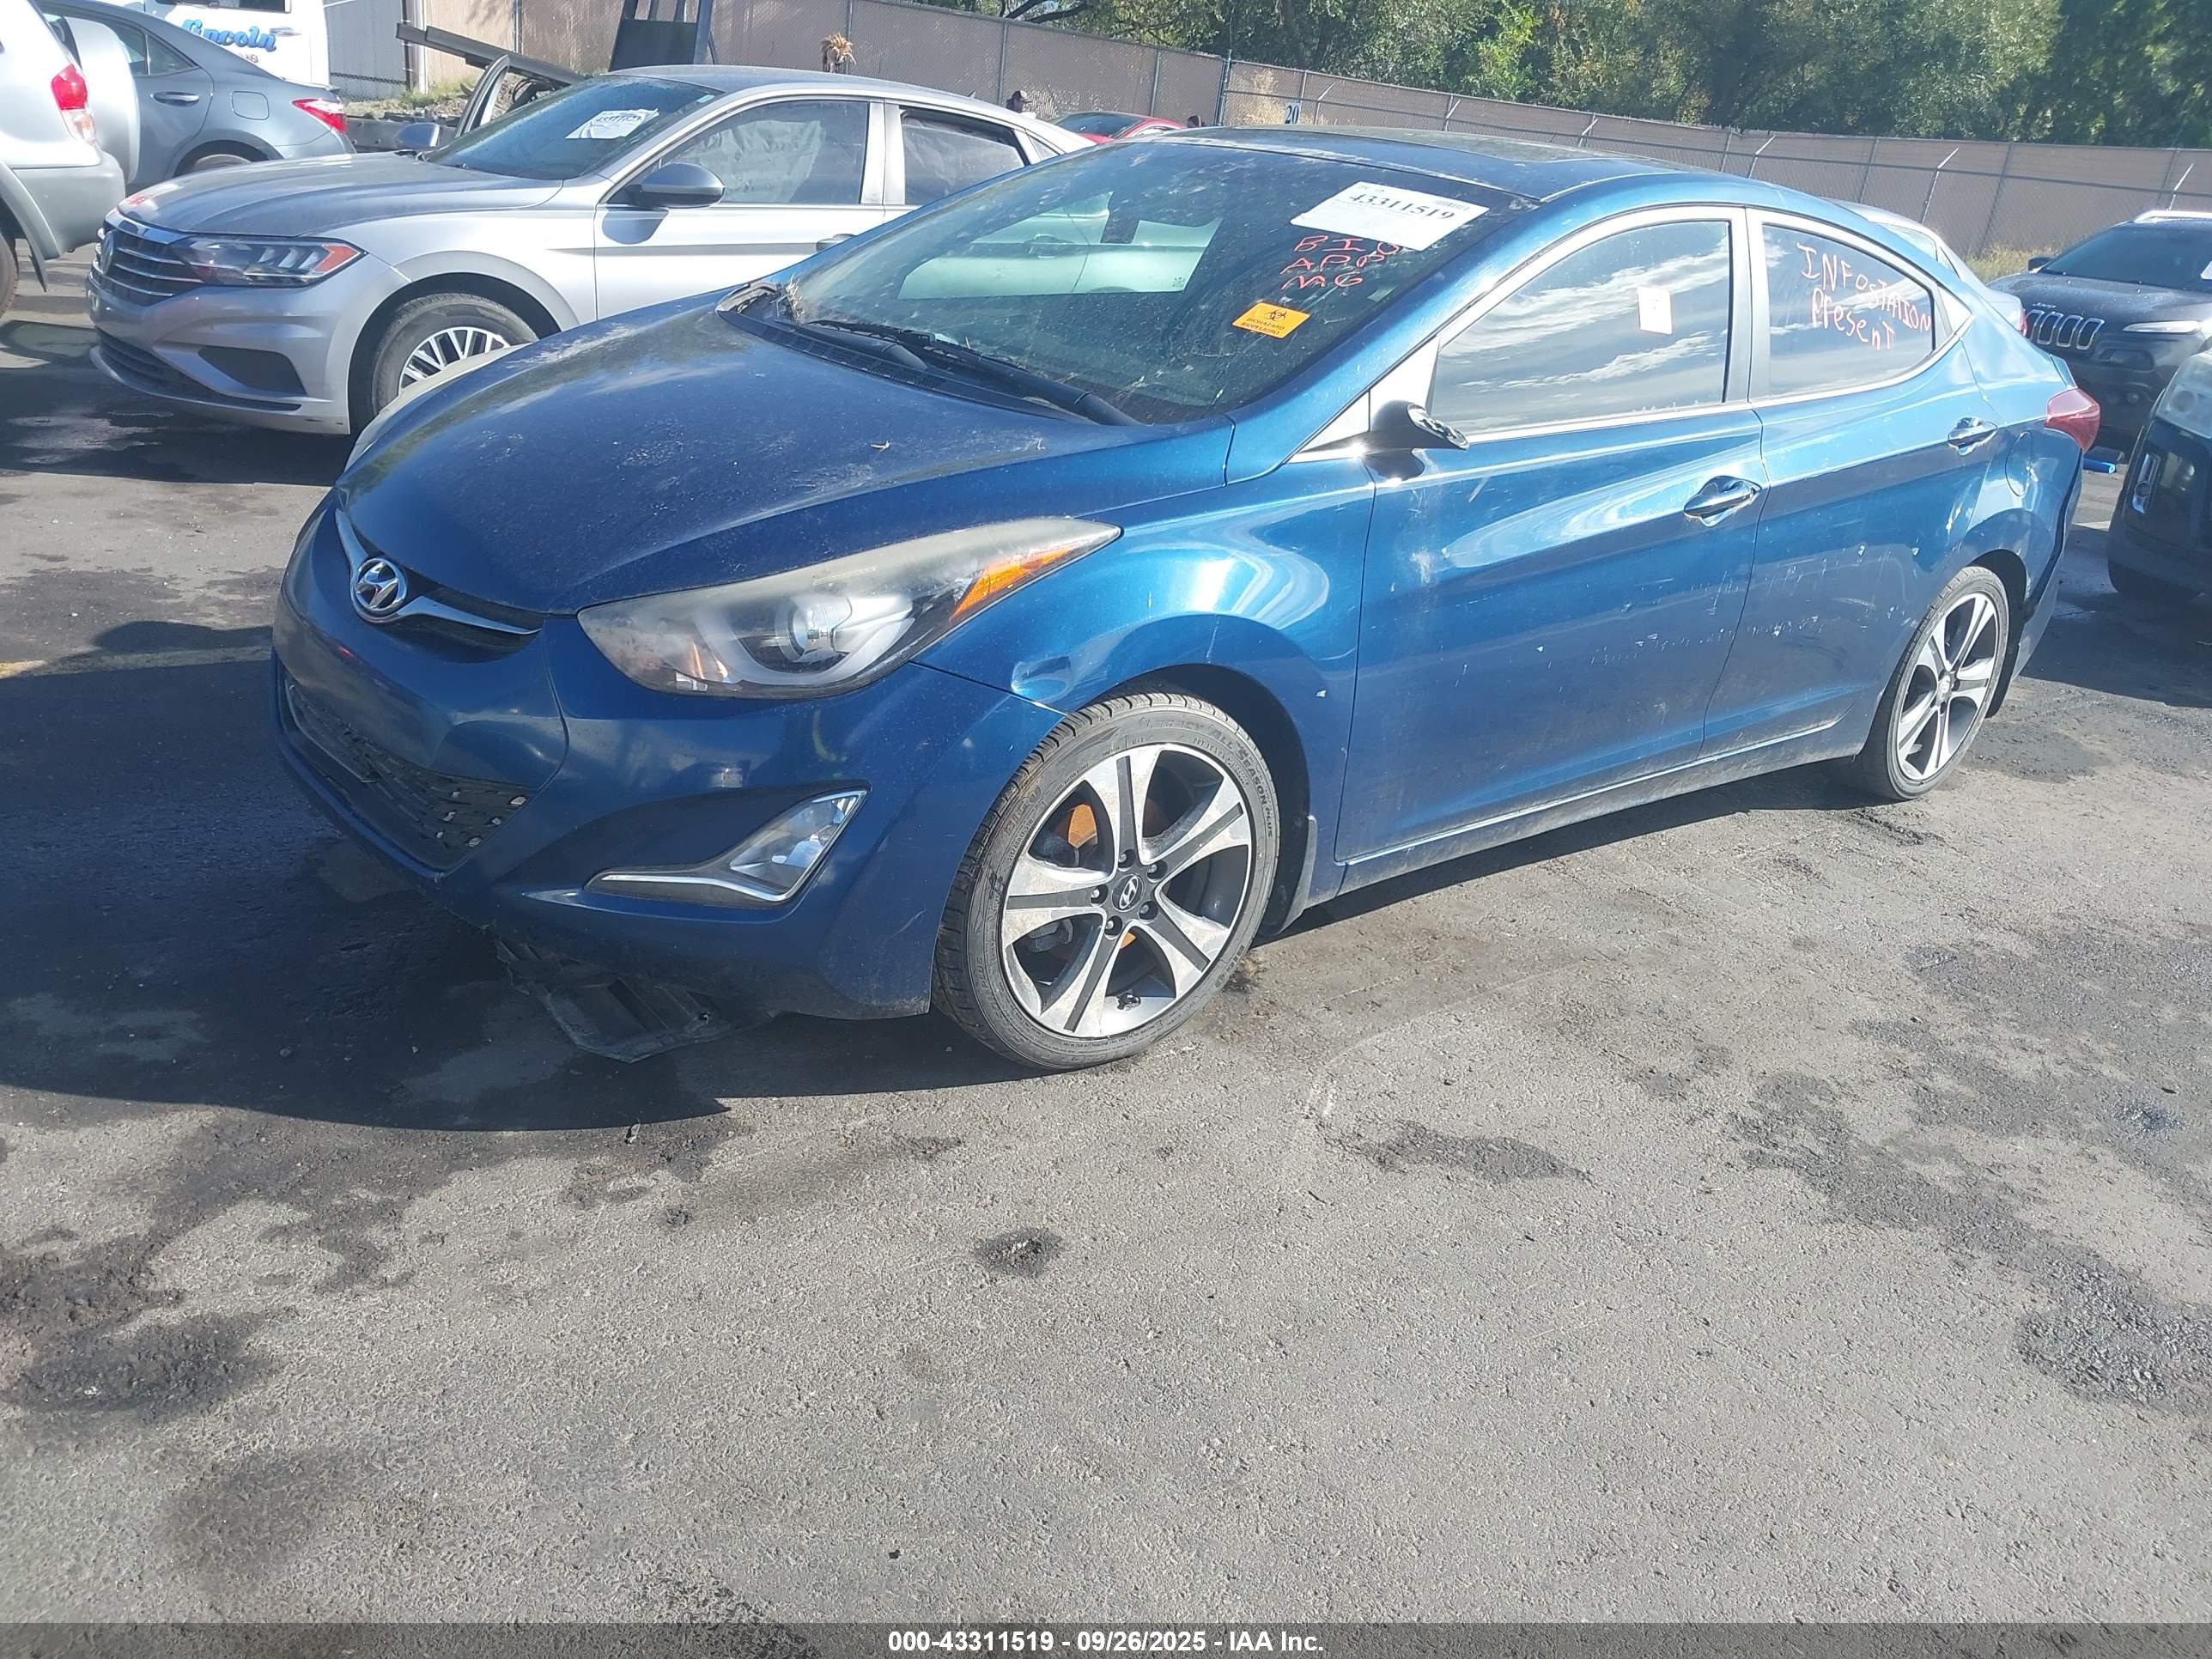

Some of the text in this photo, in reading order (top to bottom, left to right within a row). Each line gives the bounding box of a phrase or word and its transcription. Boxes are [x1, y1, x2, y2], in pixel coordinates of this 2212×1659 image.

[1284, 105, 1300, 125] 20
[1349, 193, 1455, 219] 43311519
[1293, 234, 1401, 255] BIO
[1262, 805, 1273, 839] PLUS
